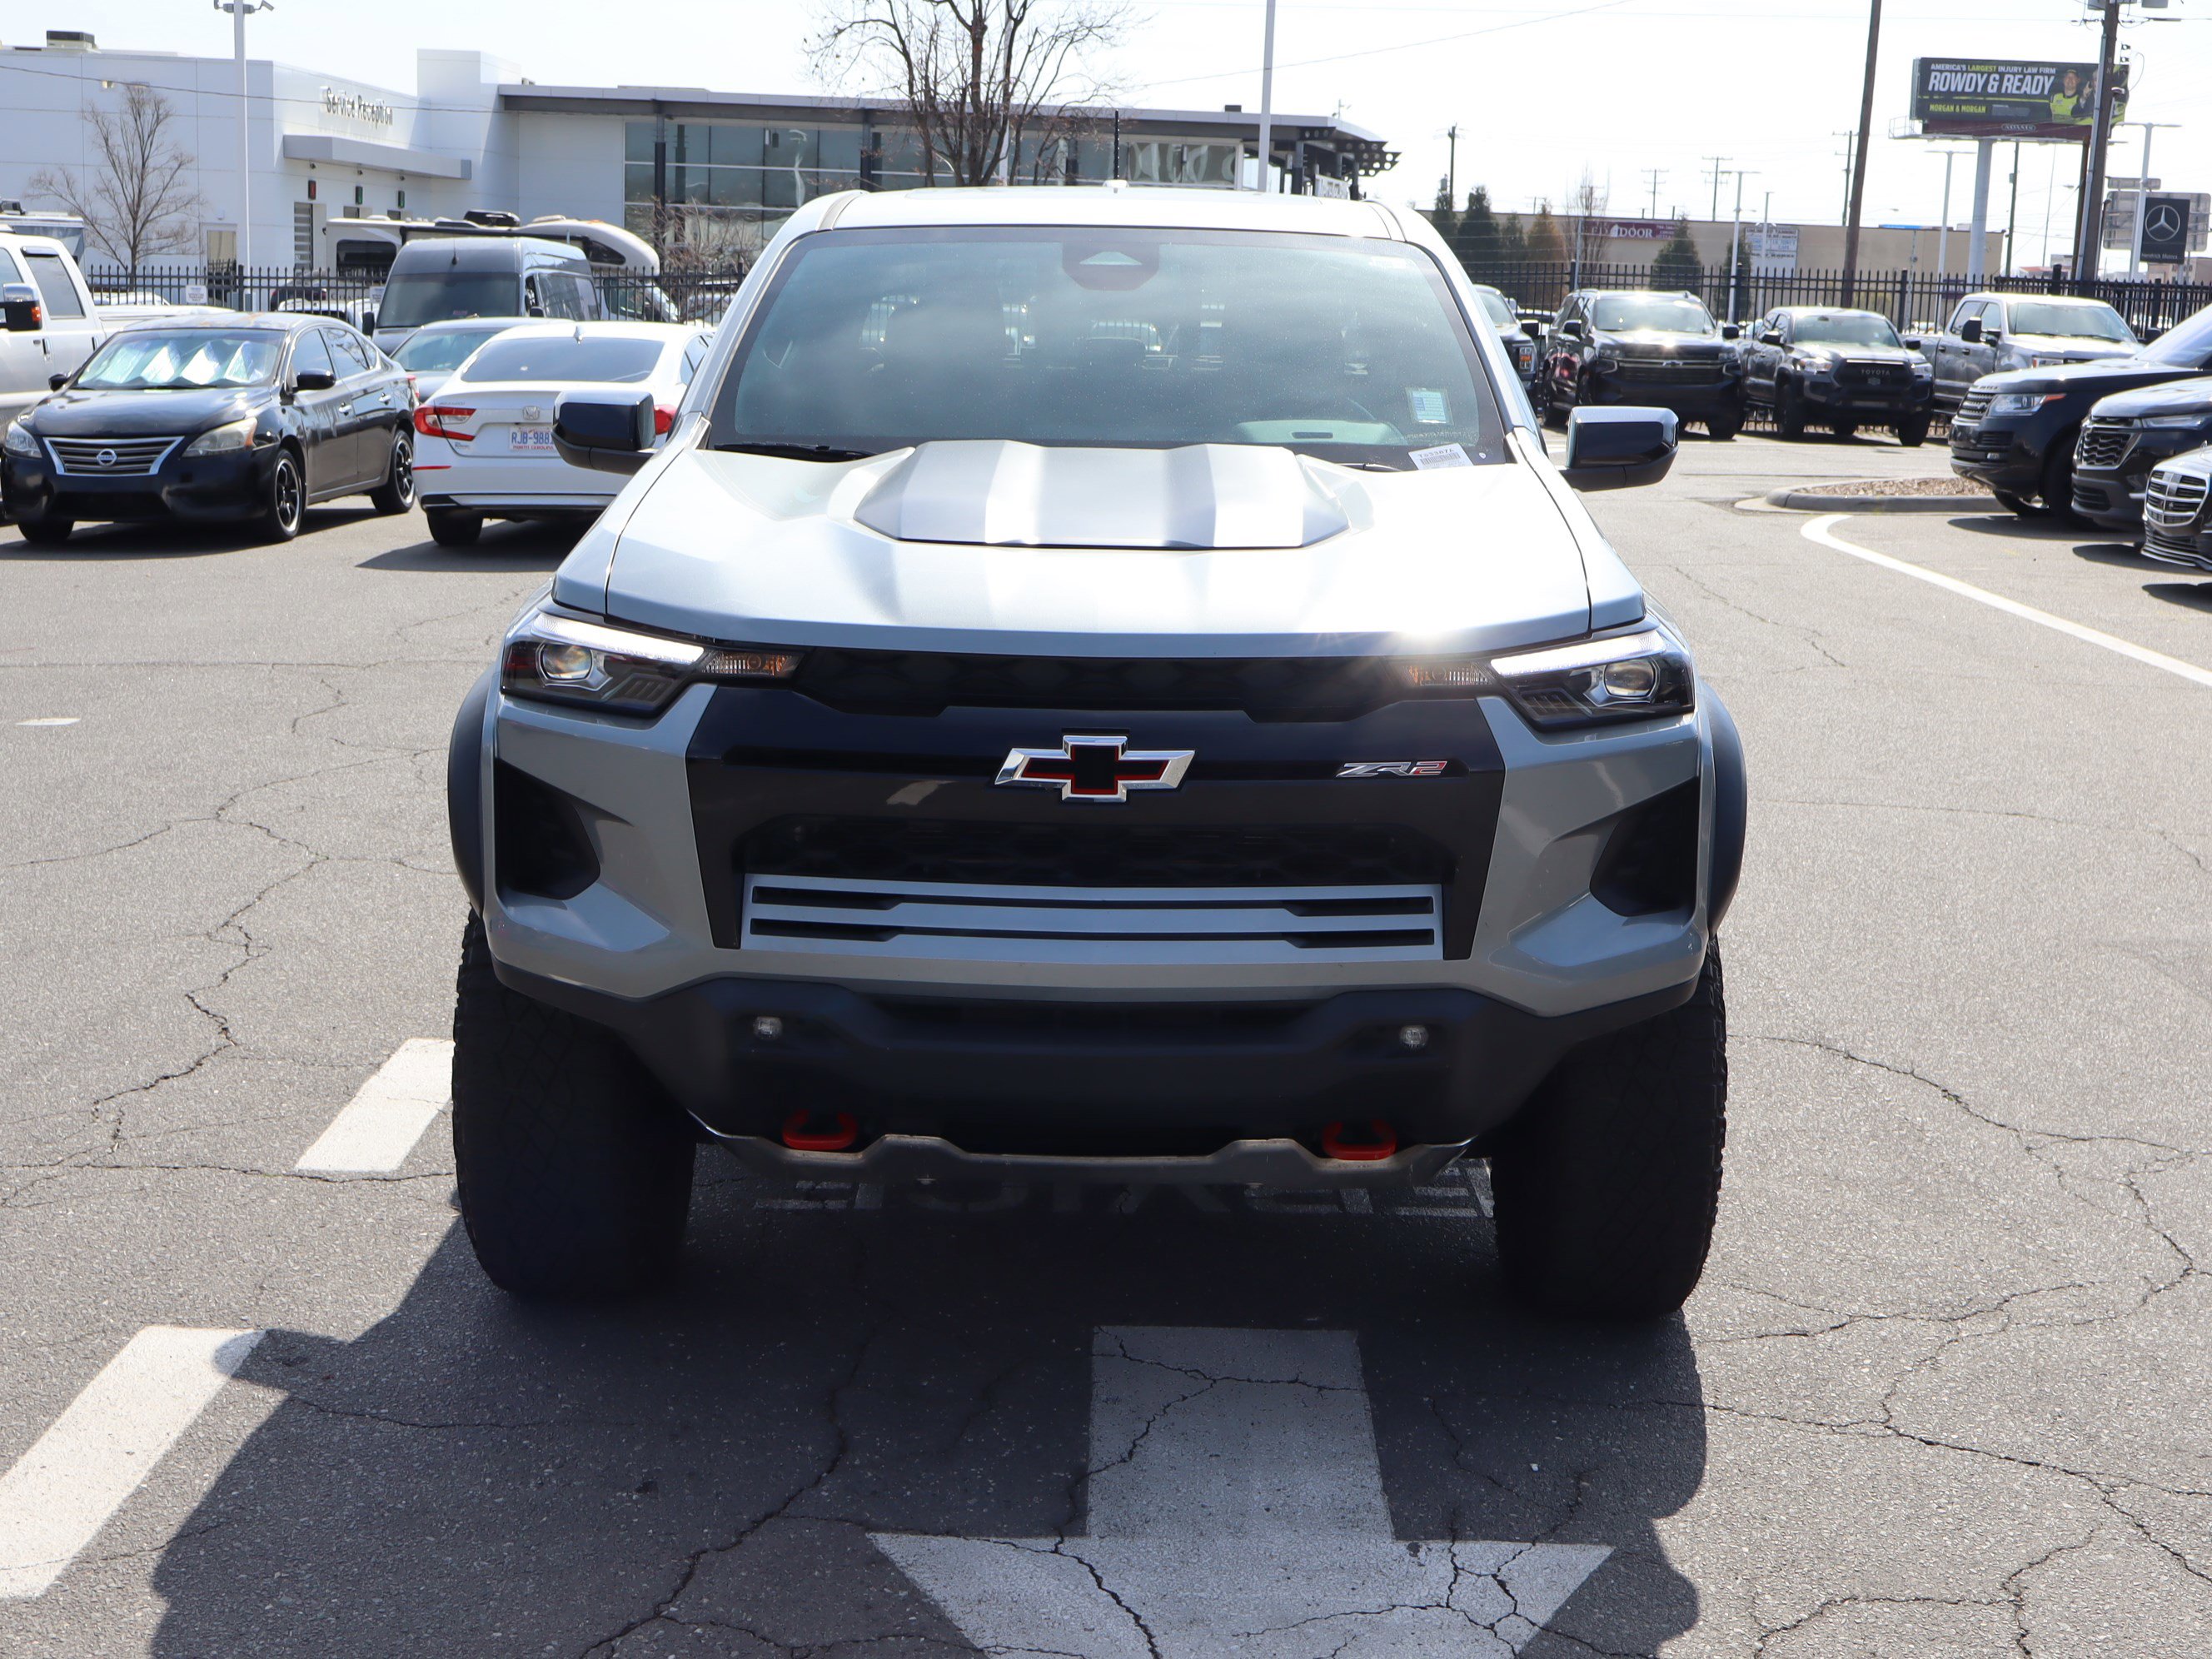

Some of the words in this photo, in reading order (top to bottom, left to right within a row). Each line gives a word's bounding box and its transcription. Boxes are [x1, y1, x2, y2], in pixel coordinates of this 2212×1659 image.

[1931, 63, 1966, 72] AMERICA'S
[1967, 64, 1997, 72] LARGEST
[1998, 65, 2022, 73] INJURY
[2023, 66, 2038, 74] LAW
[2039, 67, 2056, 75] FIRM
[1928, 72, 1988, 93] ROWDY
[1987, 73, 2000, 93] &
[2001, 74, 2055, 95] READY
[326, 87, 356, 118] Service
[358, 94, 393, 129] Reception
[1929, 104, 1955, 112] MORGAN
[1955, 105, 1960, 113] &
[1960, 105, 1986, 113] MORGAN
[1618, 227, 1653, 238] DOOR
[1335, 760, 1448, 778] ZR2
